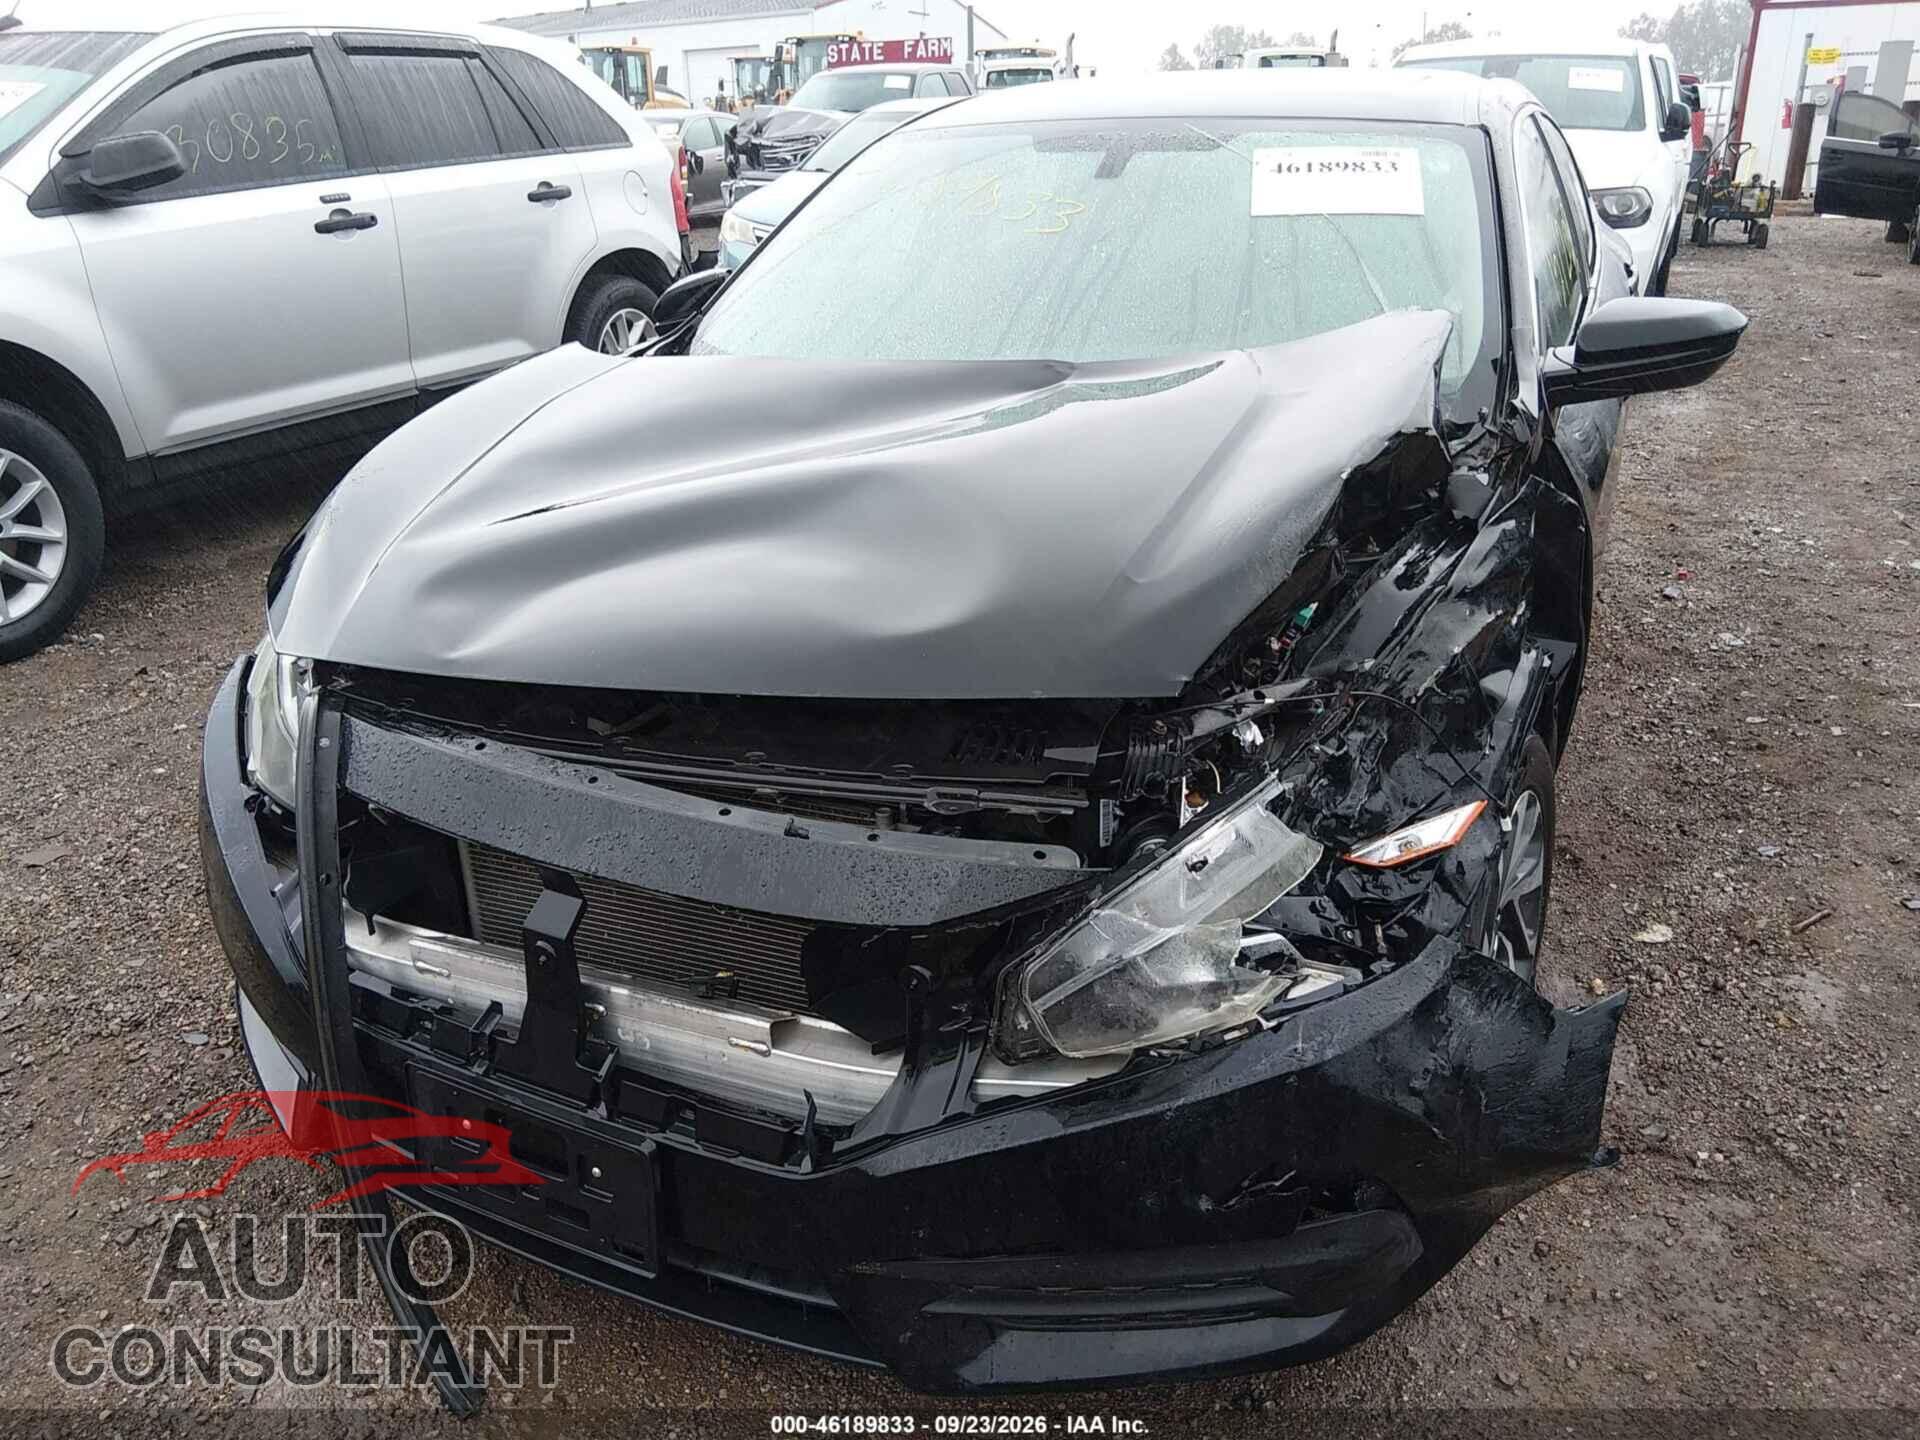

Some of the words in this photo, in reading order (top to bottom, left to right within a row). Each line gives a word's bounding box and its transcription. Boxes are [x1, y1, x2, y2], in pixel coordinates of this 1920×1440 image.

[827, 42, 885, 63] STATE
[903, 38, 952, 59] FARM
[1269, 161, 1400, 175] 46189833
